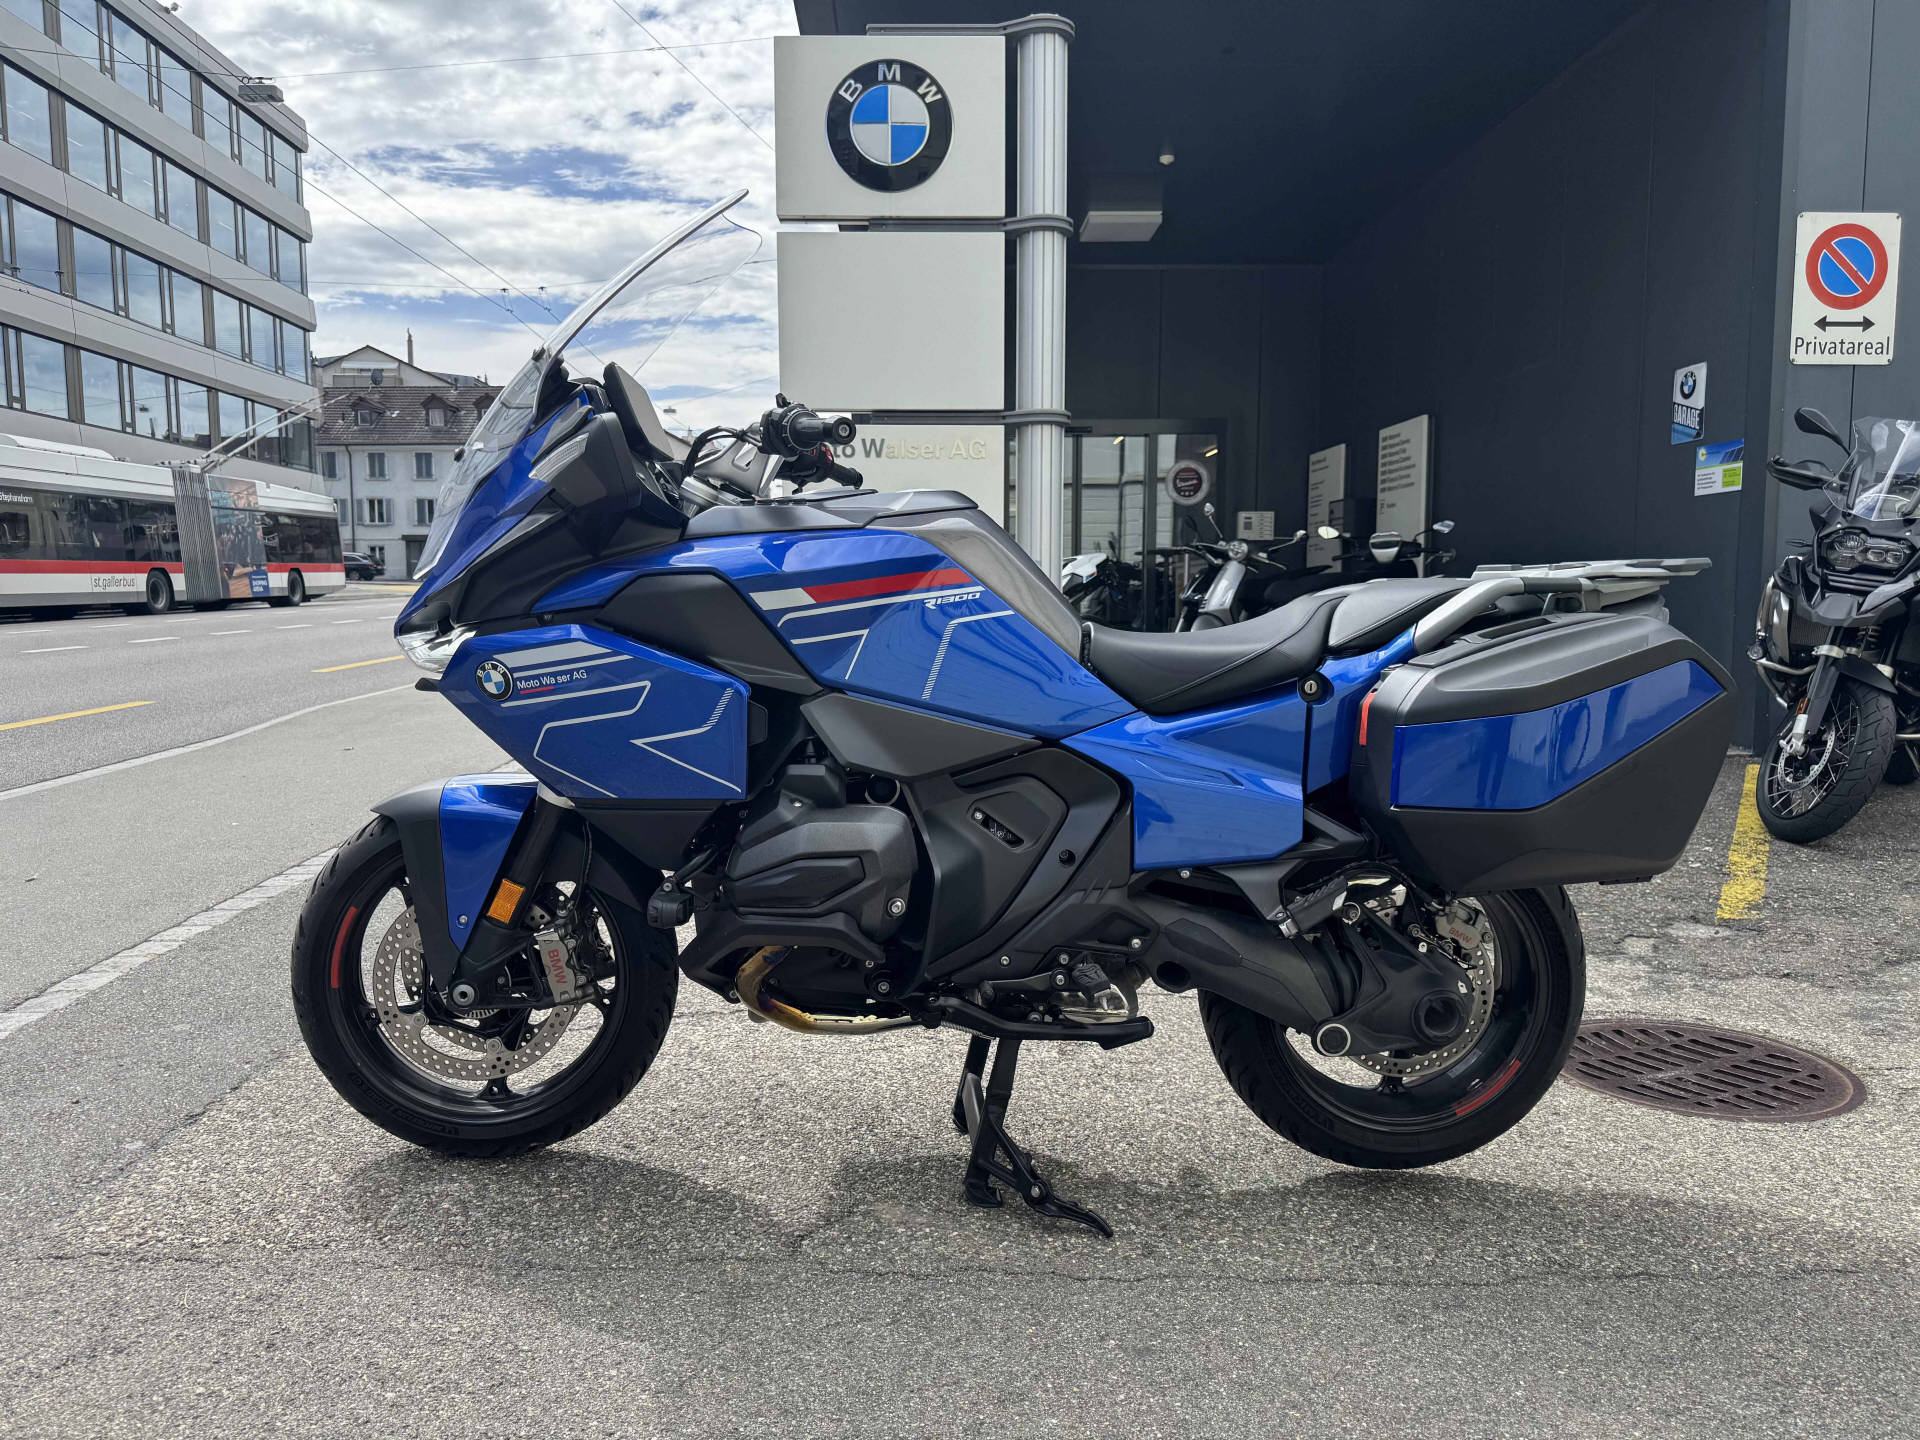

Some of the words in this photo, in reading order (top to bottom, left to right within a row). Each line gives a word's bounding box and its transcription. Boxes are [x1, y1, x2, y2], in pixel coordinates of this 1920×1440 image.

[838, 61, 943, 104] BMW
[1794, 335, 1890, 356] Privatareal
[1673, 403, 1700, 430] GARAGE
[832, 443, 856, 459] to
[861, 438, 944, 460] Walser
[949, 439, 986, 460] AG
[477, 663, 505, 678] BMW
[516, 680, 540, 690] Moto
[540, 674, 571, 687] Waser
[573, 669, 587, 680] AG
[1449, 927, 1472, 943] BMW
[548, 948, 568, 984] BMW
